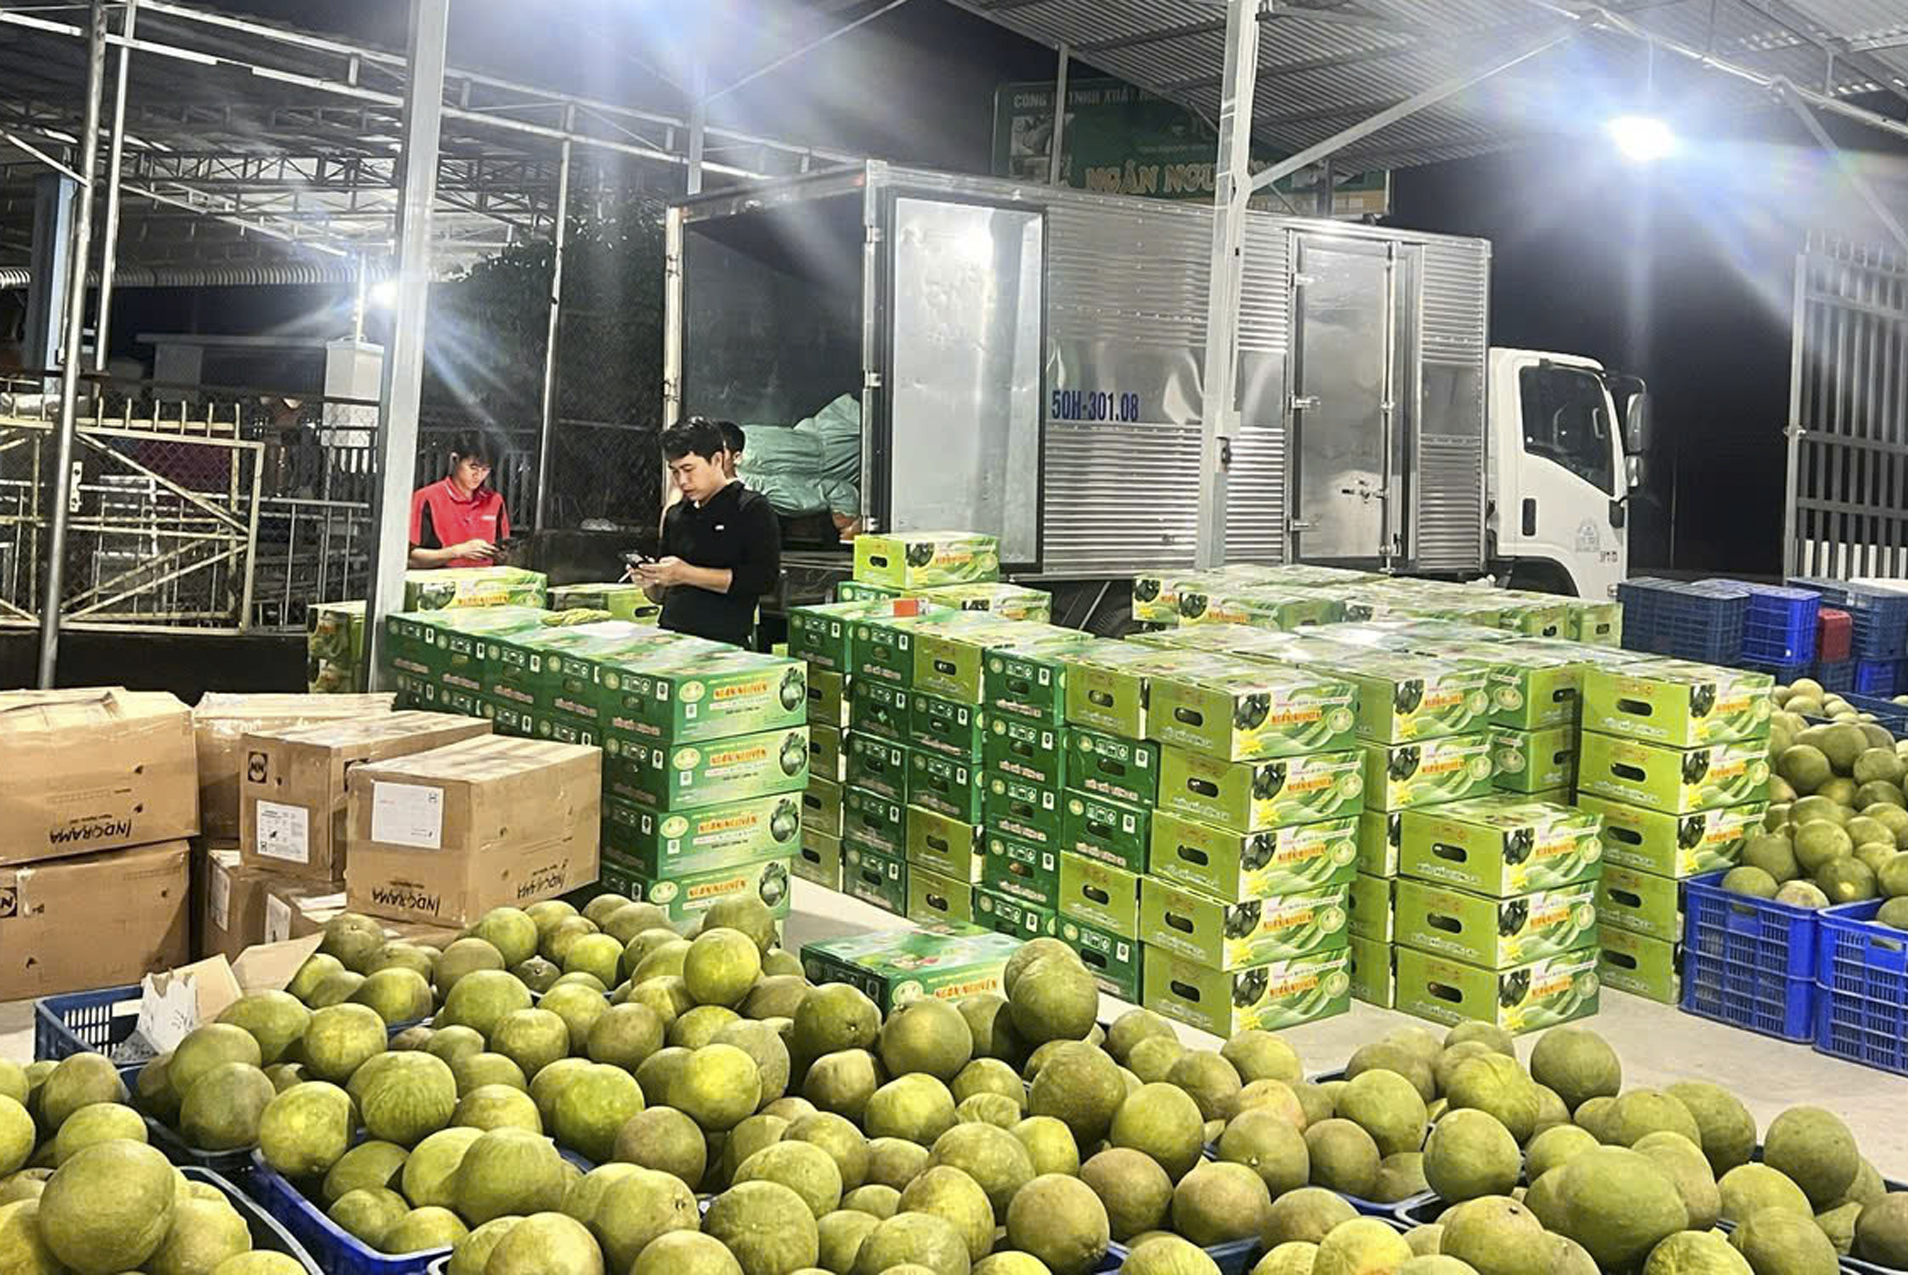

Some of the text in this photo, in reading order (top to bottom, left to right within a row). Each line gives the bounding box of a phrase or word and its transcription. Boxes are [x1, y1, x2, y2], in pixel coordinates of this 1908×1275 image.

[1051, 390, 1139, 422] 50H-301.08
[50, 818, 131, 844] INDORAMA
[372, 887, 440, 917] INDORAMA
